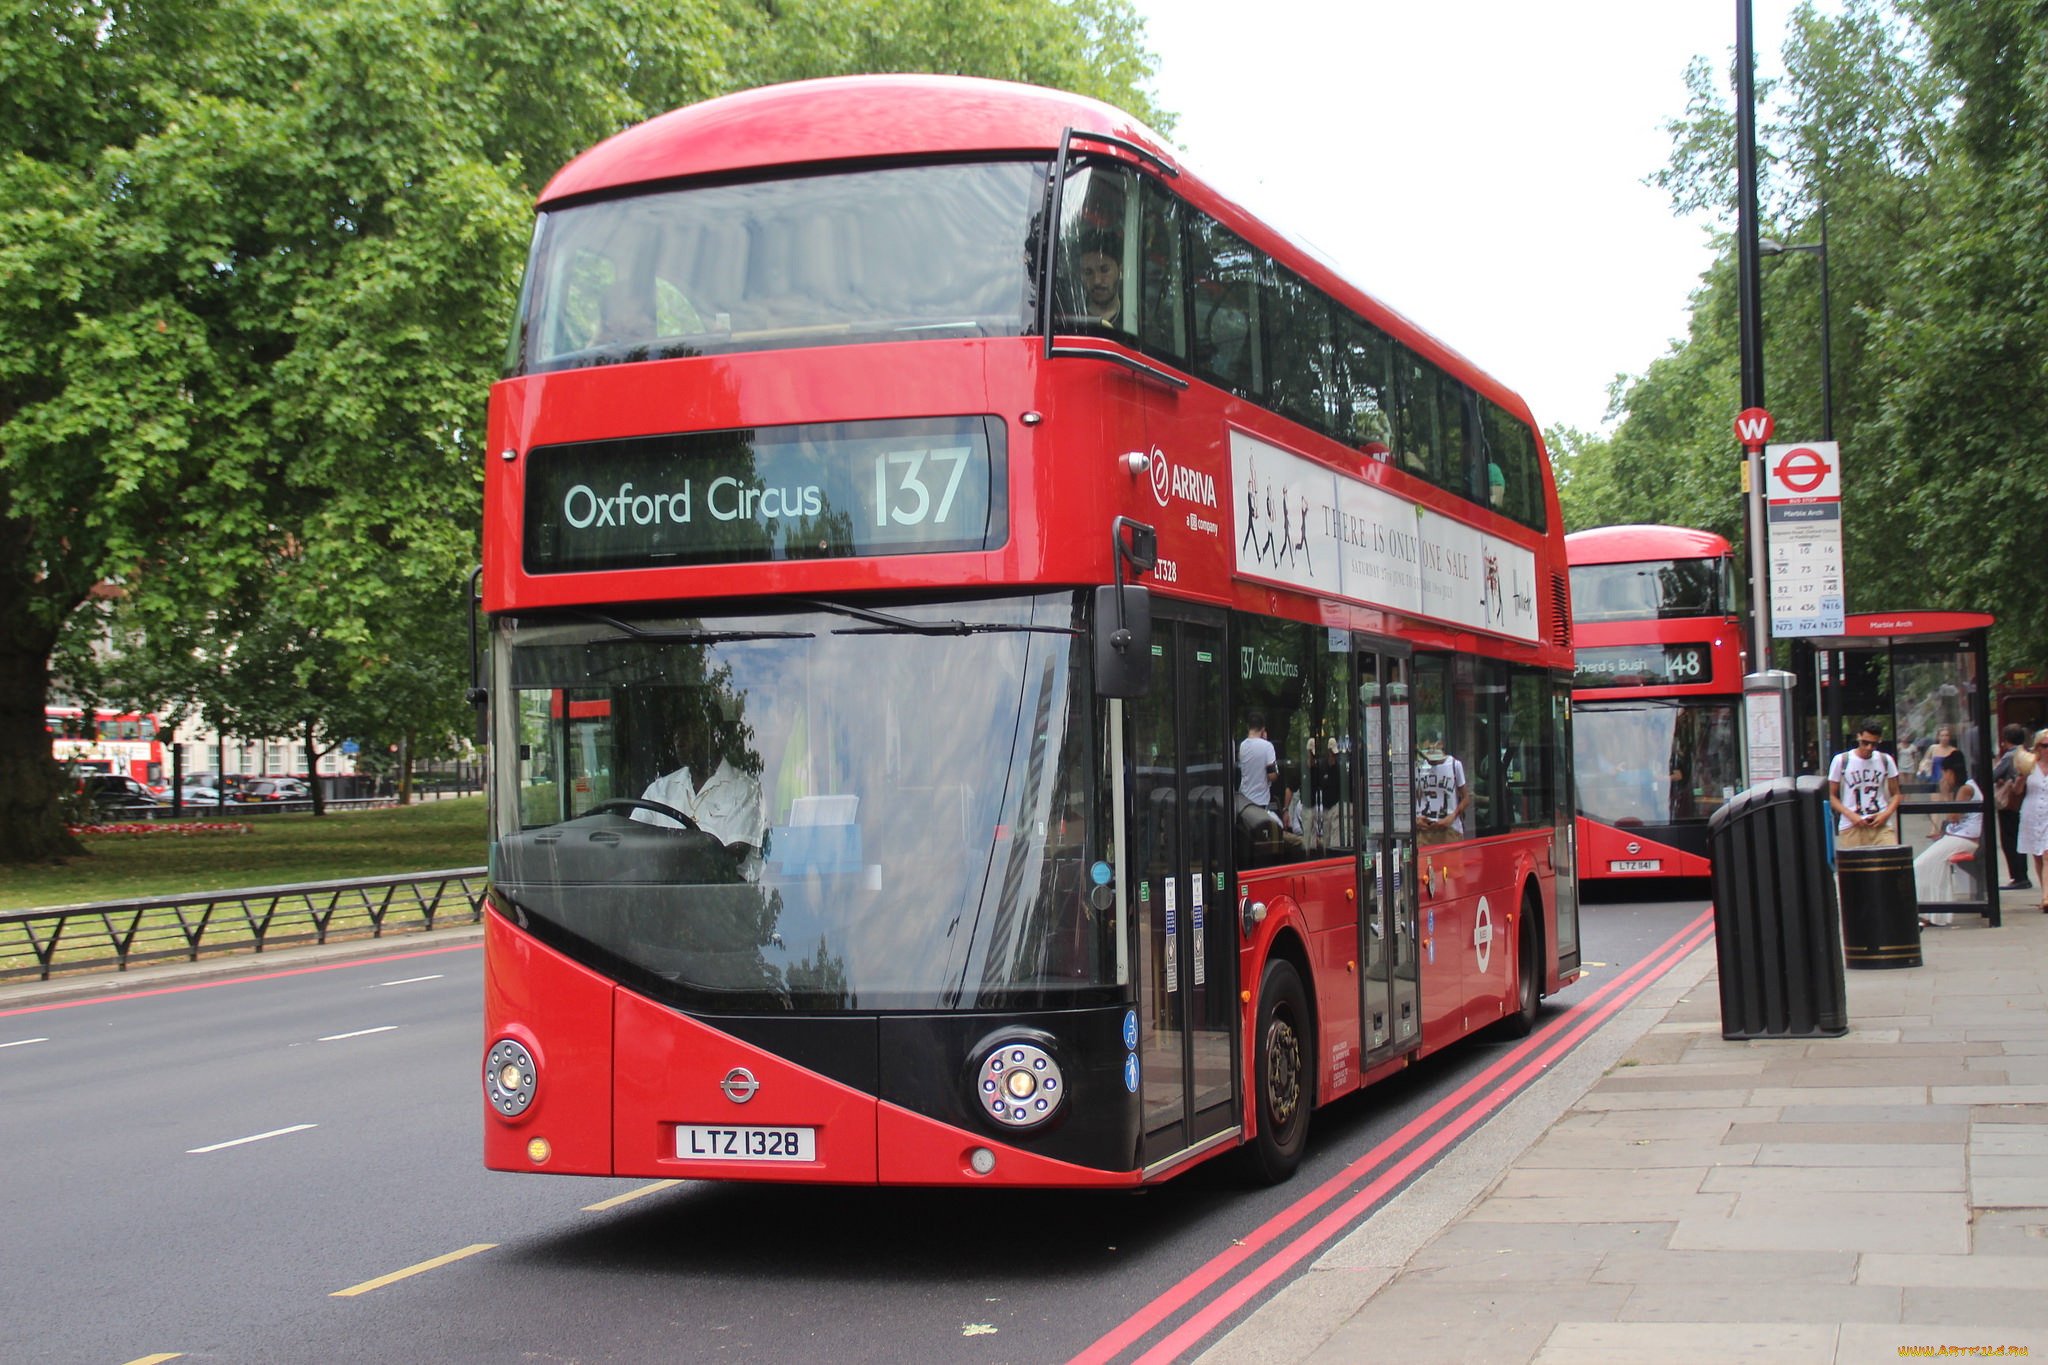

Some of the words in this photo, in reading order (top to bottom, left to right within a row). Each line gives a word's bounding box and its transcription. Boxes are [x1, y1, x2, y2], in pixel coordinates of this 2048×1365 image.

[1738, 417, 1768, 440] W
[875, 446, 972, 527] 137
[1171, 464, 1218, 508] ARRIVA
[564, 479, 691, 528] Oxford
[707, 475, 822, 522] Circus
[1197, 519, 1219, 537] company
[1322, 505, 1367, 548] THERE
[1372, 522, 1385, 553] IS
[1389, 528, 1417, 564] ONLY
[1422, 540, 1442, 572] ONE
[1446, 549, 1469, 580] SALE
[1154, 558, 1177, 582] LT328
[1799, 584, 1813, 592] 137
[1895, 620, 1913, 628] Arch
[1257, 654, 1280, 675] Oxford
[1280, 656, 1299, 678] Circus
[1619, 658, 1647, 672] Bush
[1665, 651, 1700, 676] 148
[1853, 786, 1879, 815] 13
[1619, 862, 1637, 870] LTZ
[691, 1130, 738, 1154] LTZ
[745, 1131, 799, 1156] 1328
